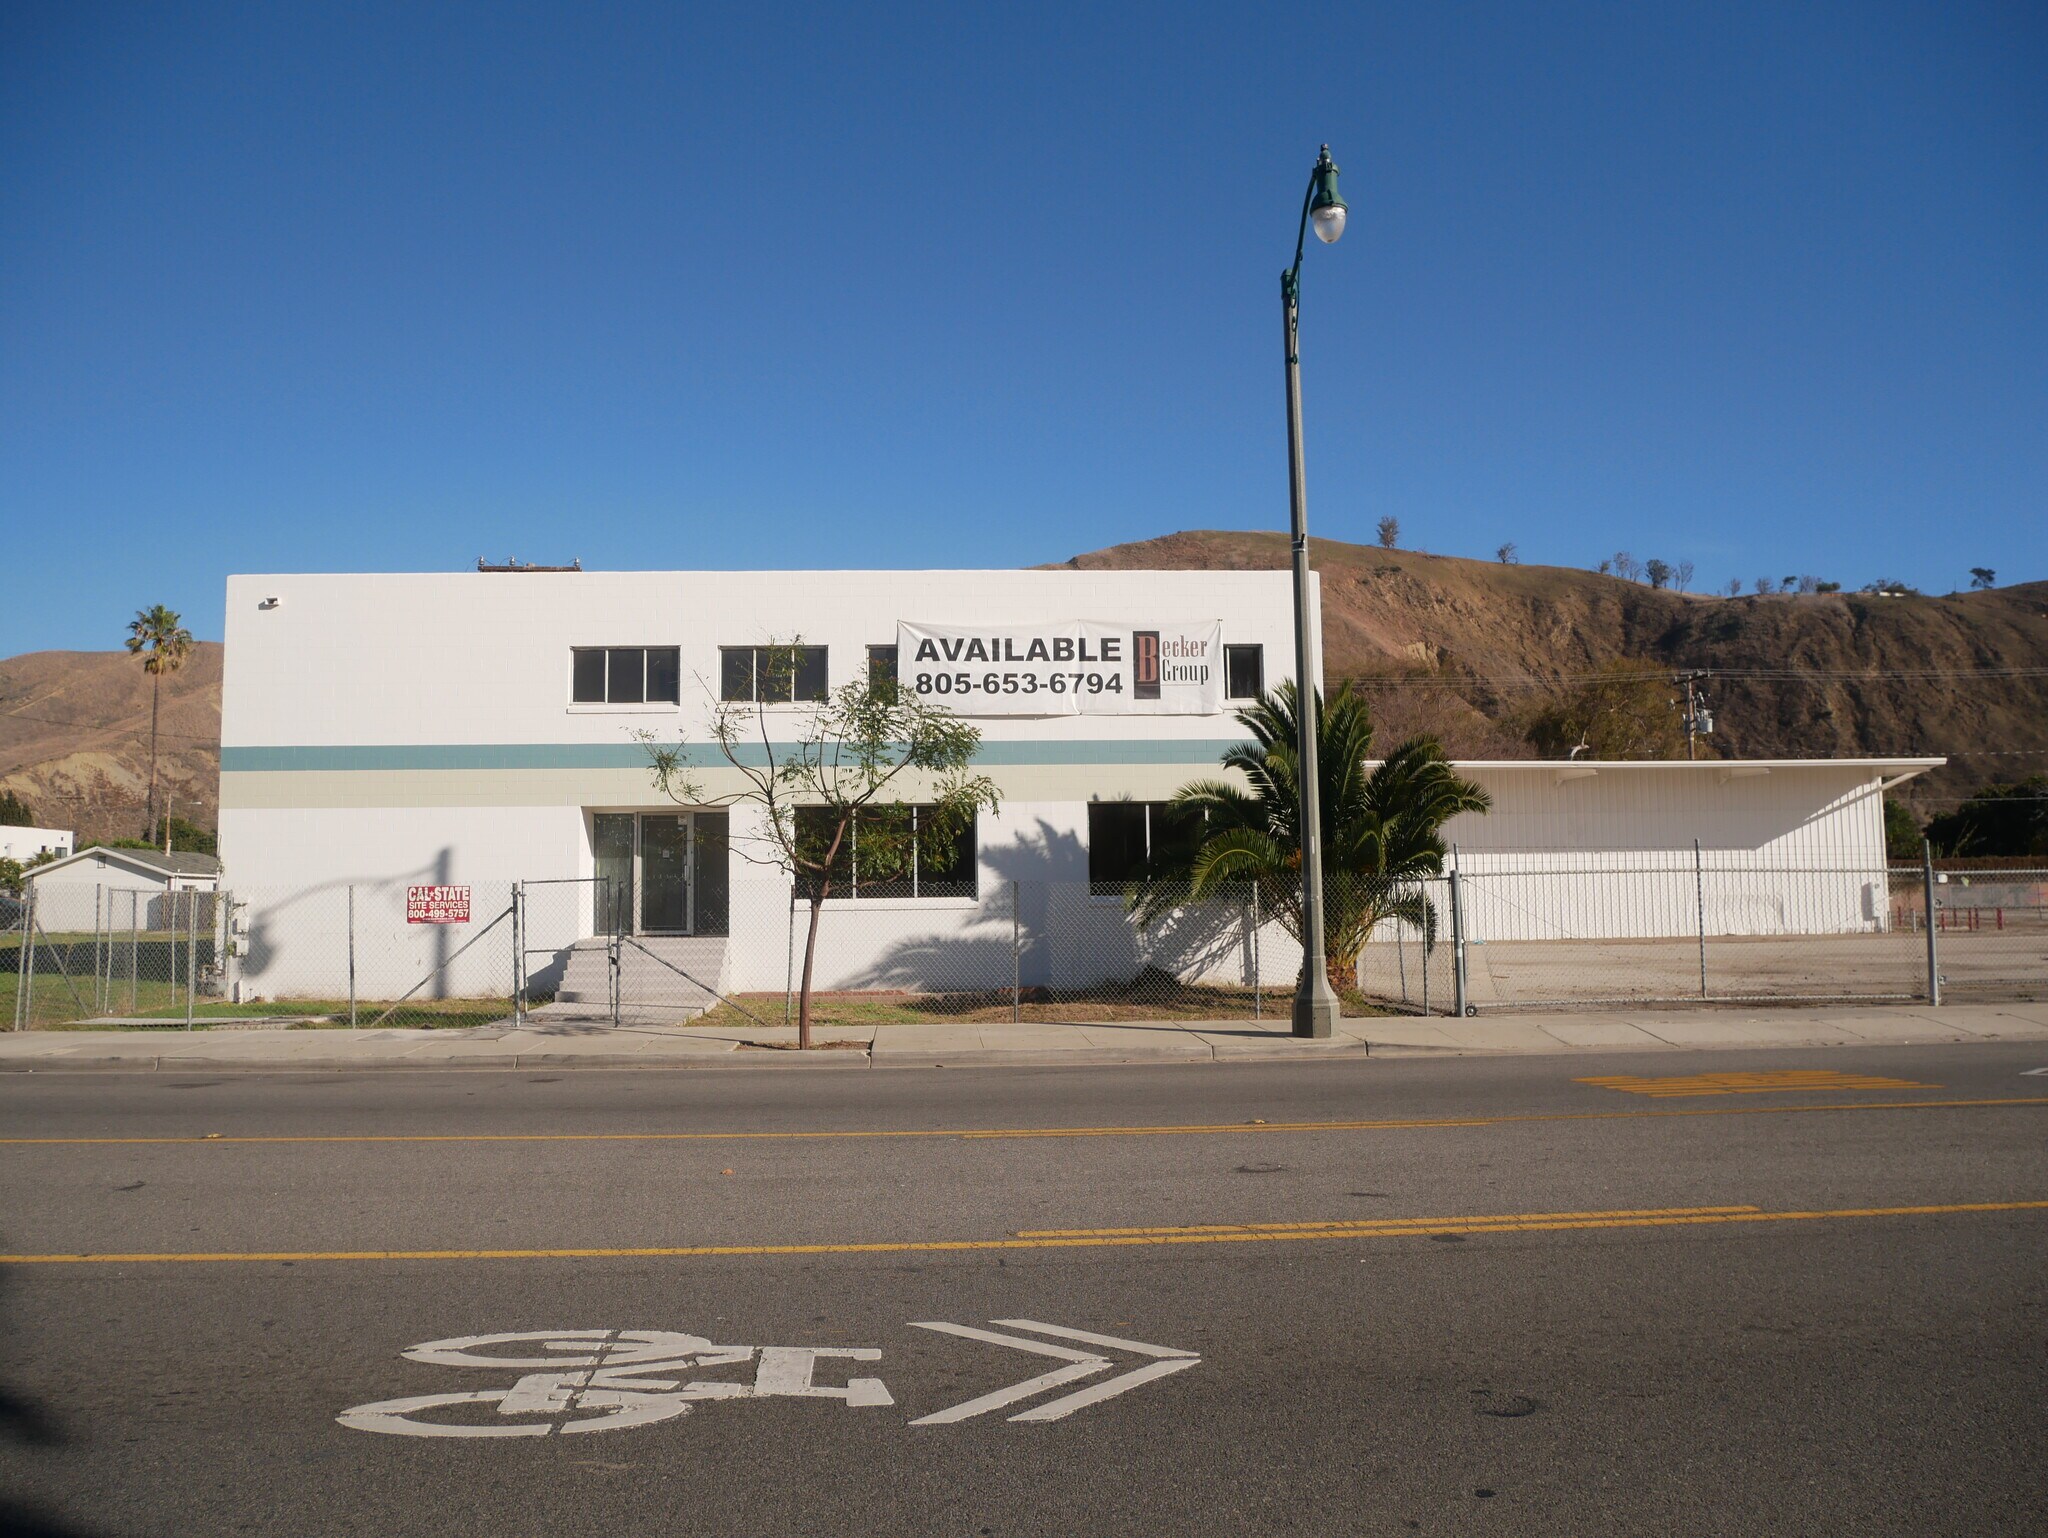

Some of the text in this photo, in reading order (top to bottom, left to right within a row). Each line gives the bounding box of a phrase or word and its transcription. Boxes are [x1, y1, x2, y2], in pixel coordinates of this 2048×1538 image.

[914, 637, 1122, 662] AVAILABLE
[1136, 634, 1208, 682] Becker
[914, 672, 1123, 695] 805-653-6794
[1162, 658, 1209, 685] Group
[408, 901, 469, 909] SITE SERVICES
